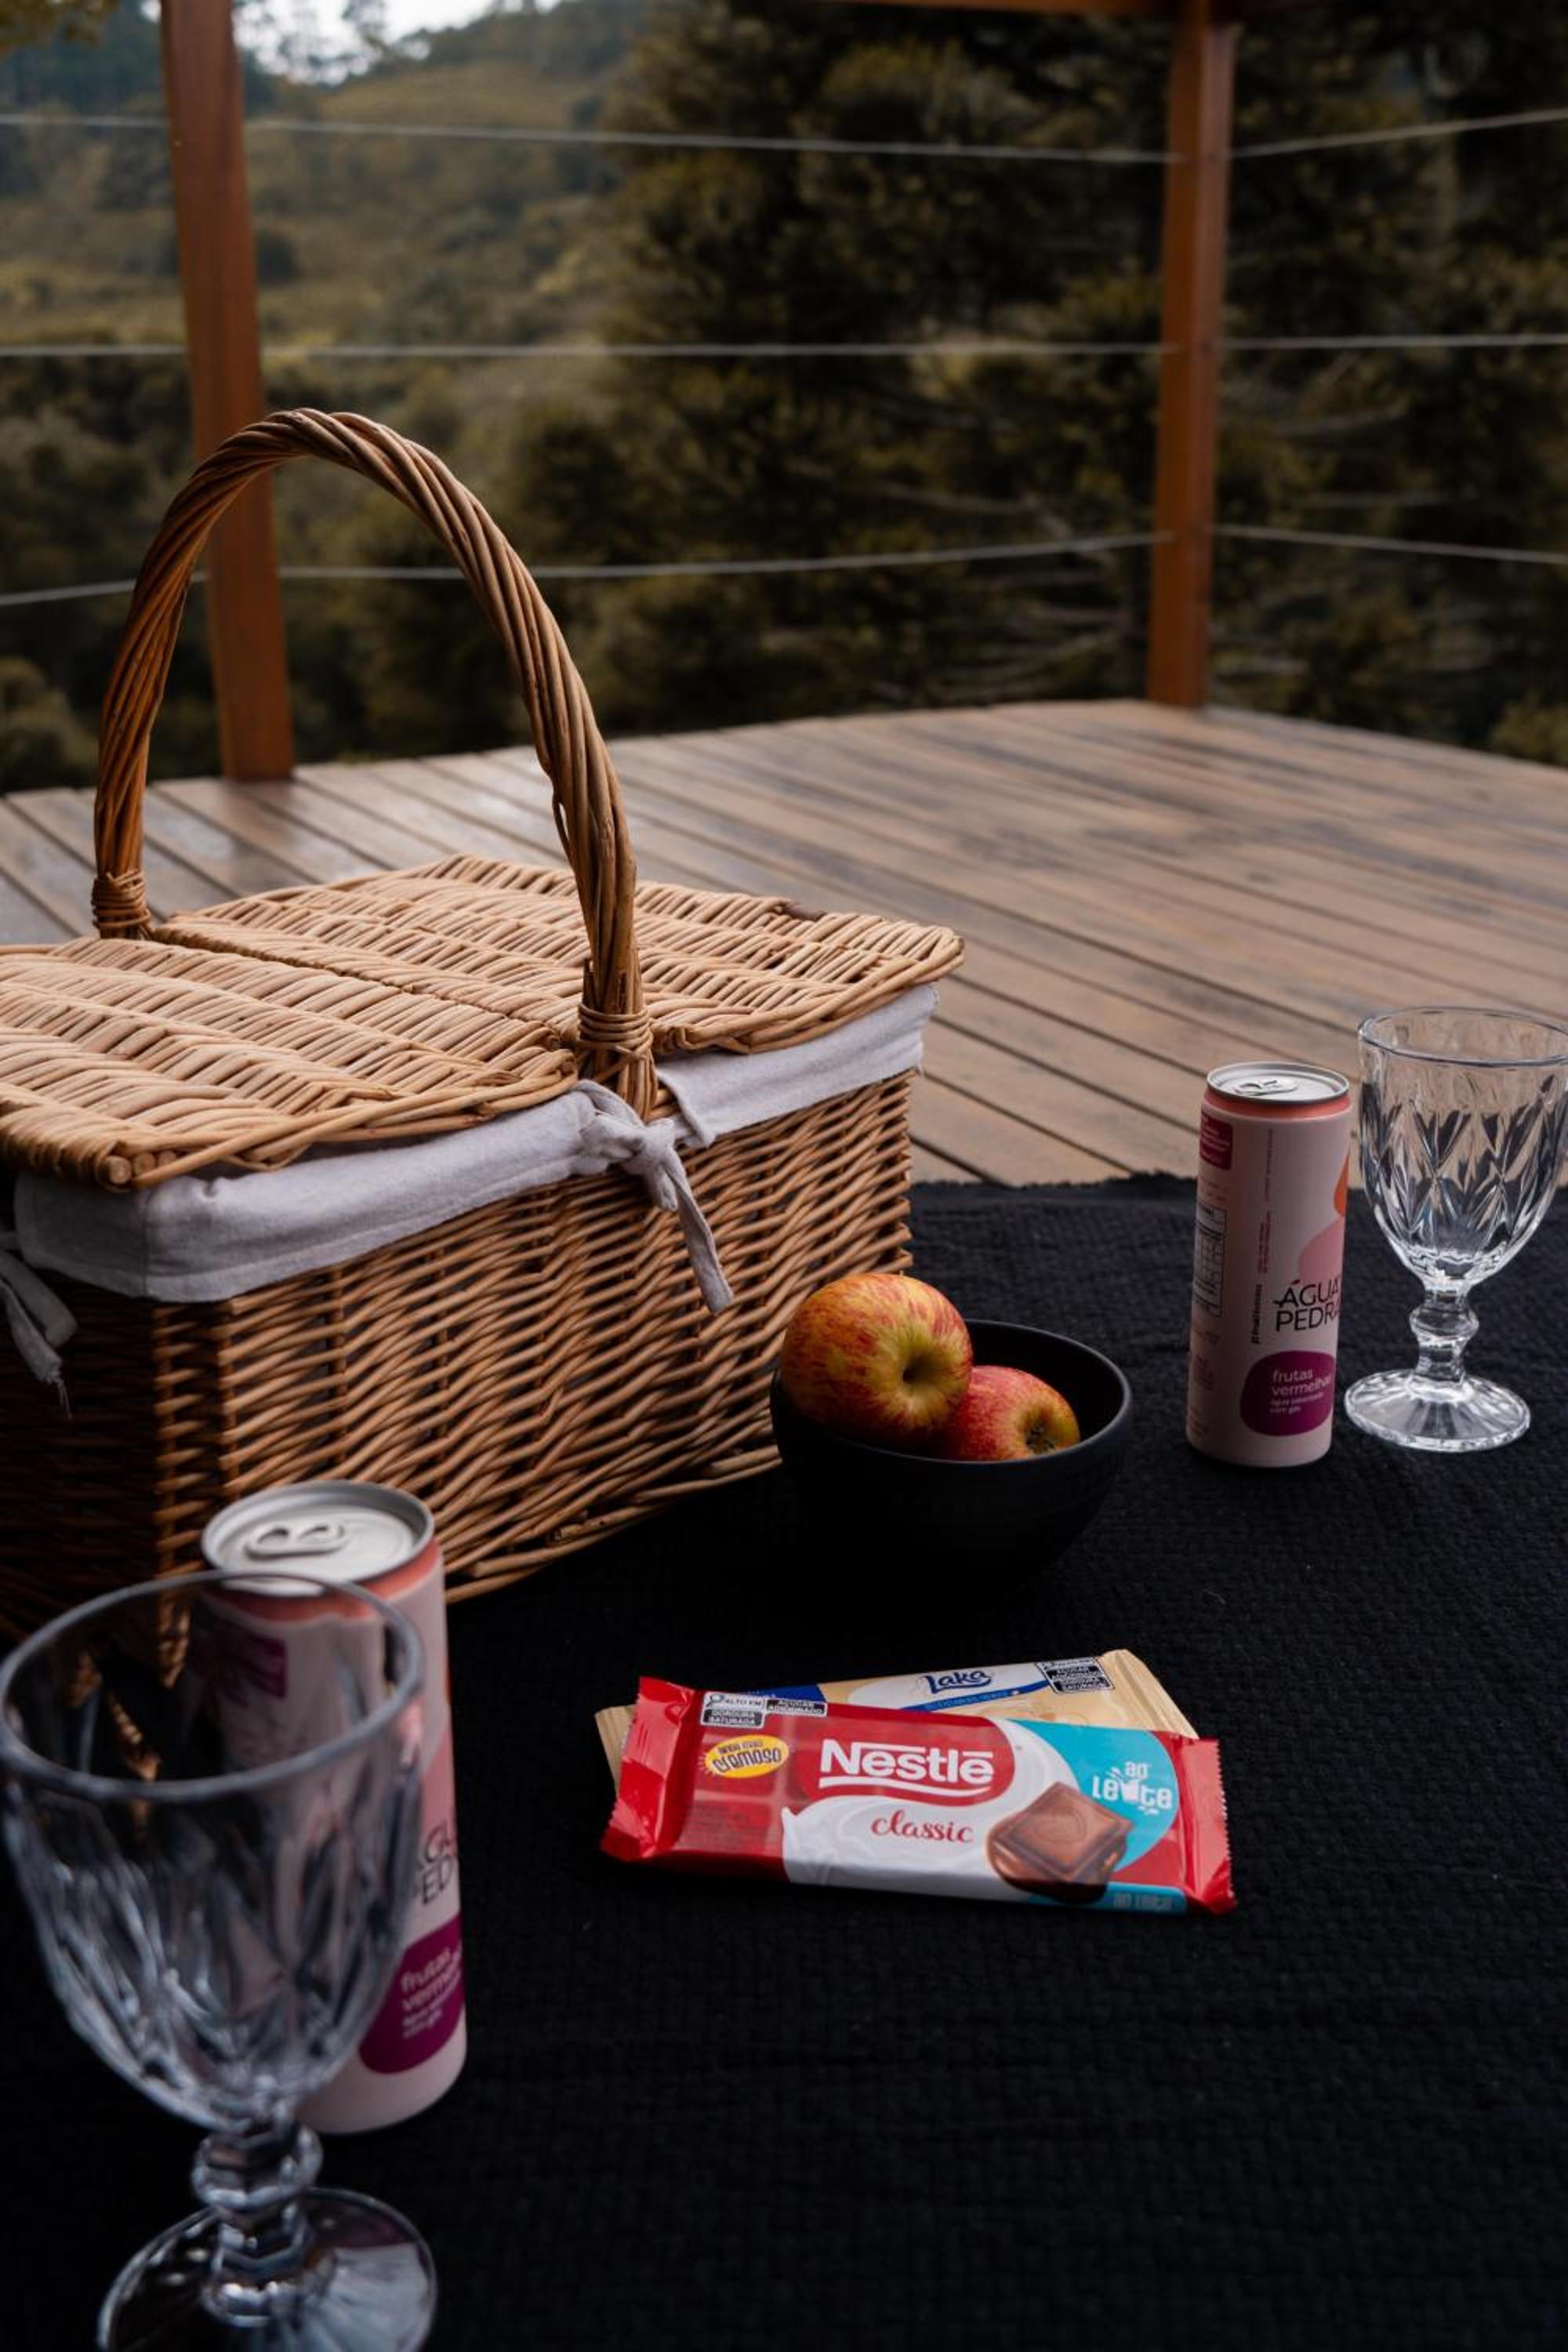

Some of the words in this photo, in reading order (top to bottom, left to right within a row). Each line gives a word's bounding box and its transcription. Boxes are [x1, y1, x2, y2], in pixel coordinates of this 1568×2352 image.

[1276, 1301, 1338, 1332] PEDR
[1272, 1368, 1313, 1384] frutas
[924, 1671, 992, 1693] Laka
[871, 1809, 974, 1842] classic
